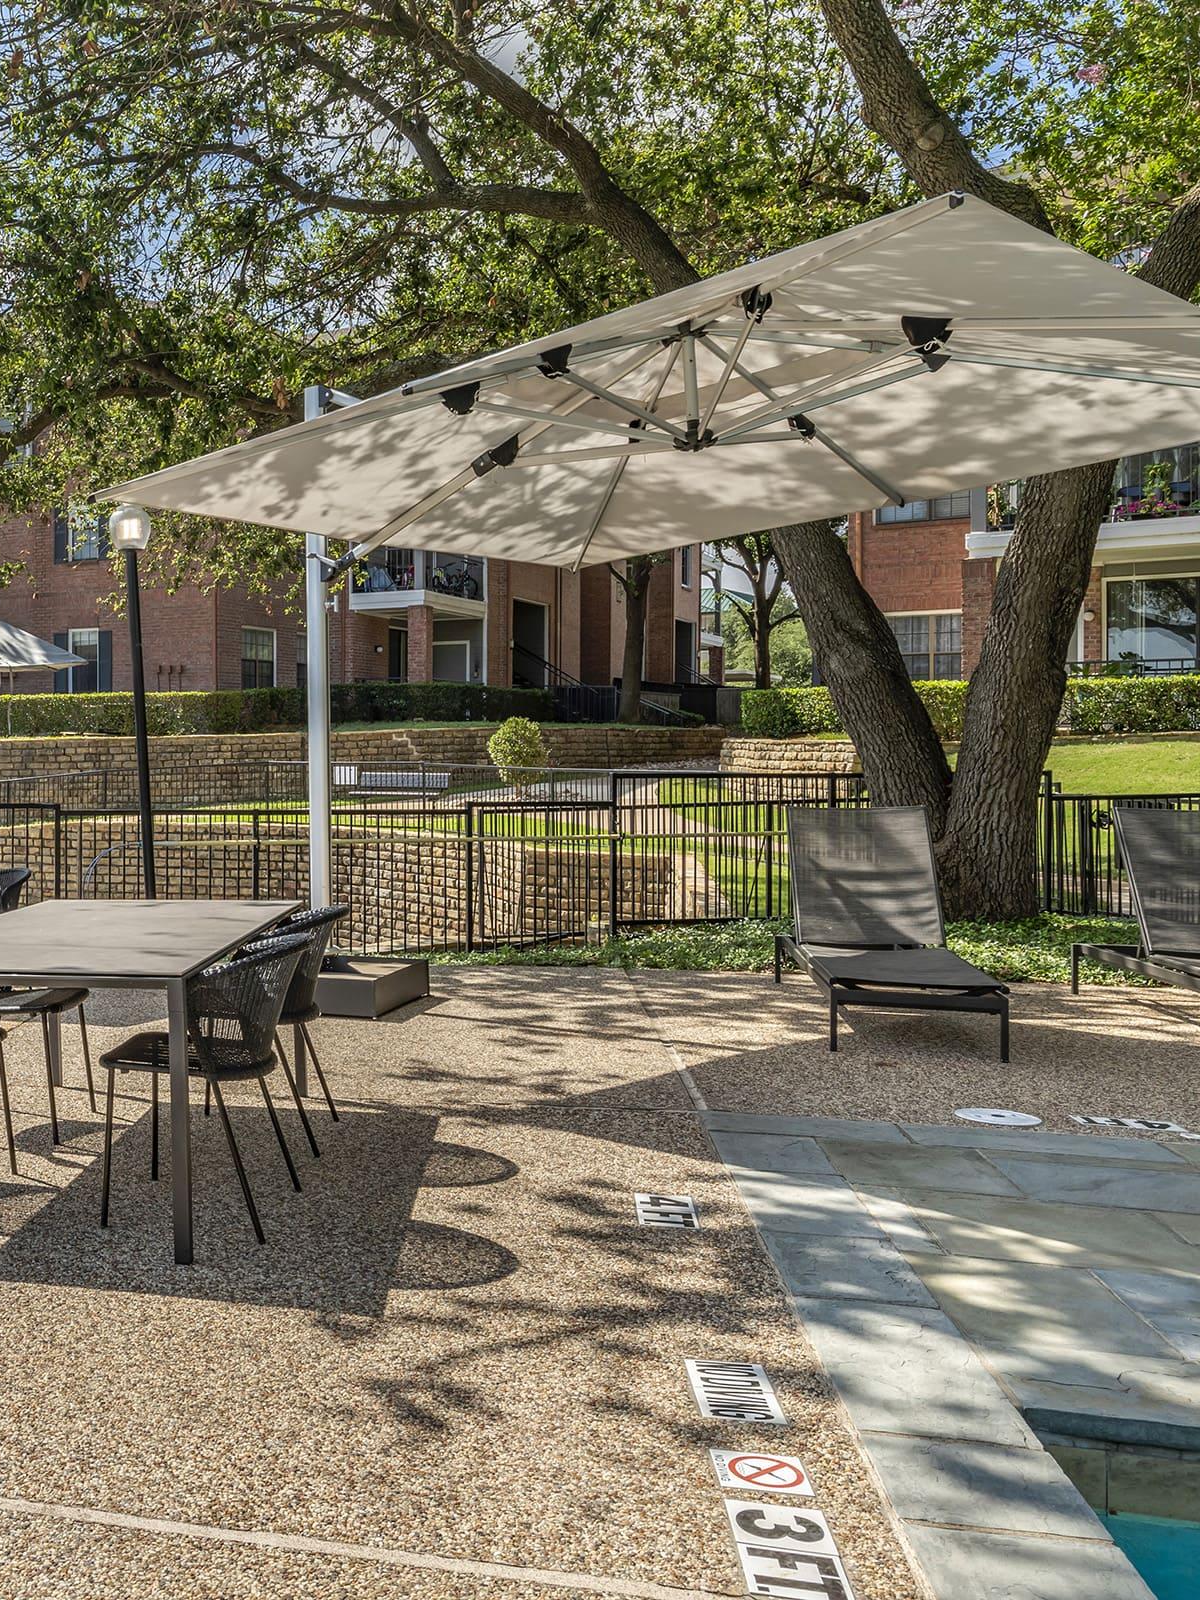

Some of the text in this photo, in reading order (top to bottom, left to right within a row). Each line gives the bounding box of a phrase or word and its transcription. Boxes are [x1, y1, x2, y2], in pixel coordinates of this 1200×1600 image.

[1134, 1120, 1171, 1130] 4
[640, 1196, 689, 1208] 4
[694, 1360, 775, 1420] NO DIVING
[714, 1454, 731, 1482] NO DIVING
[735, 1509, 825, 1543] 3
